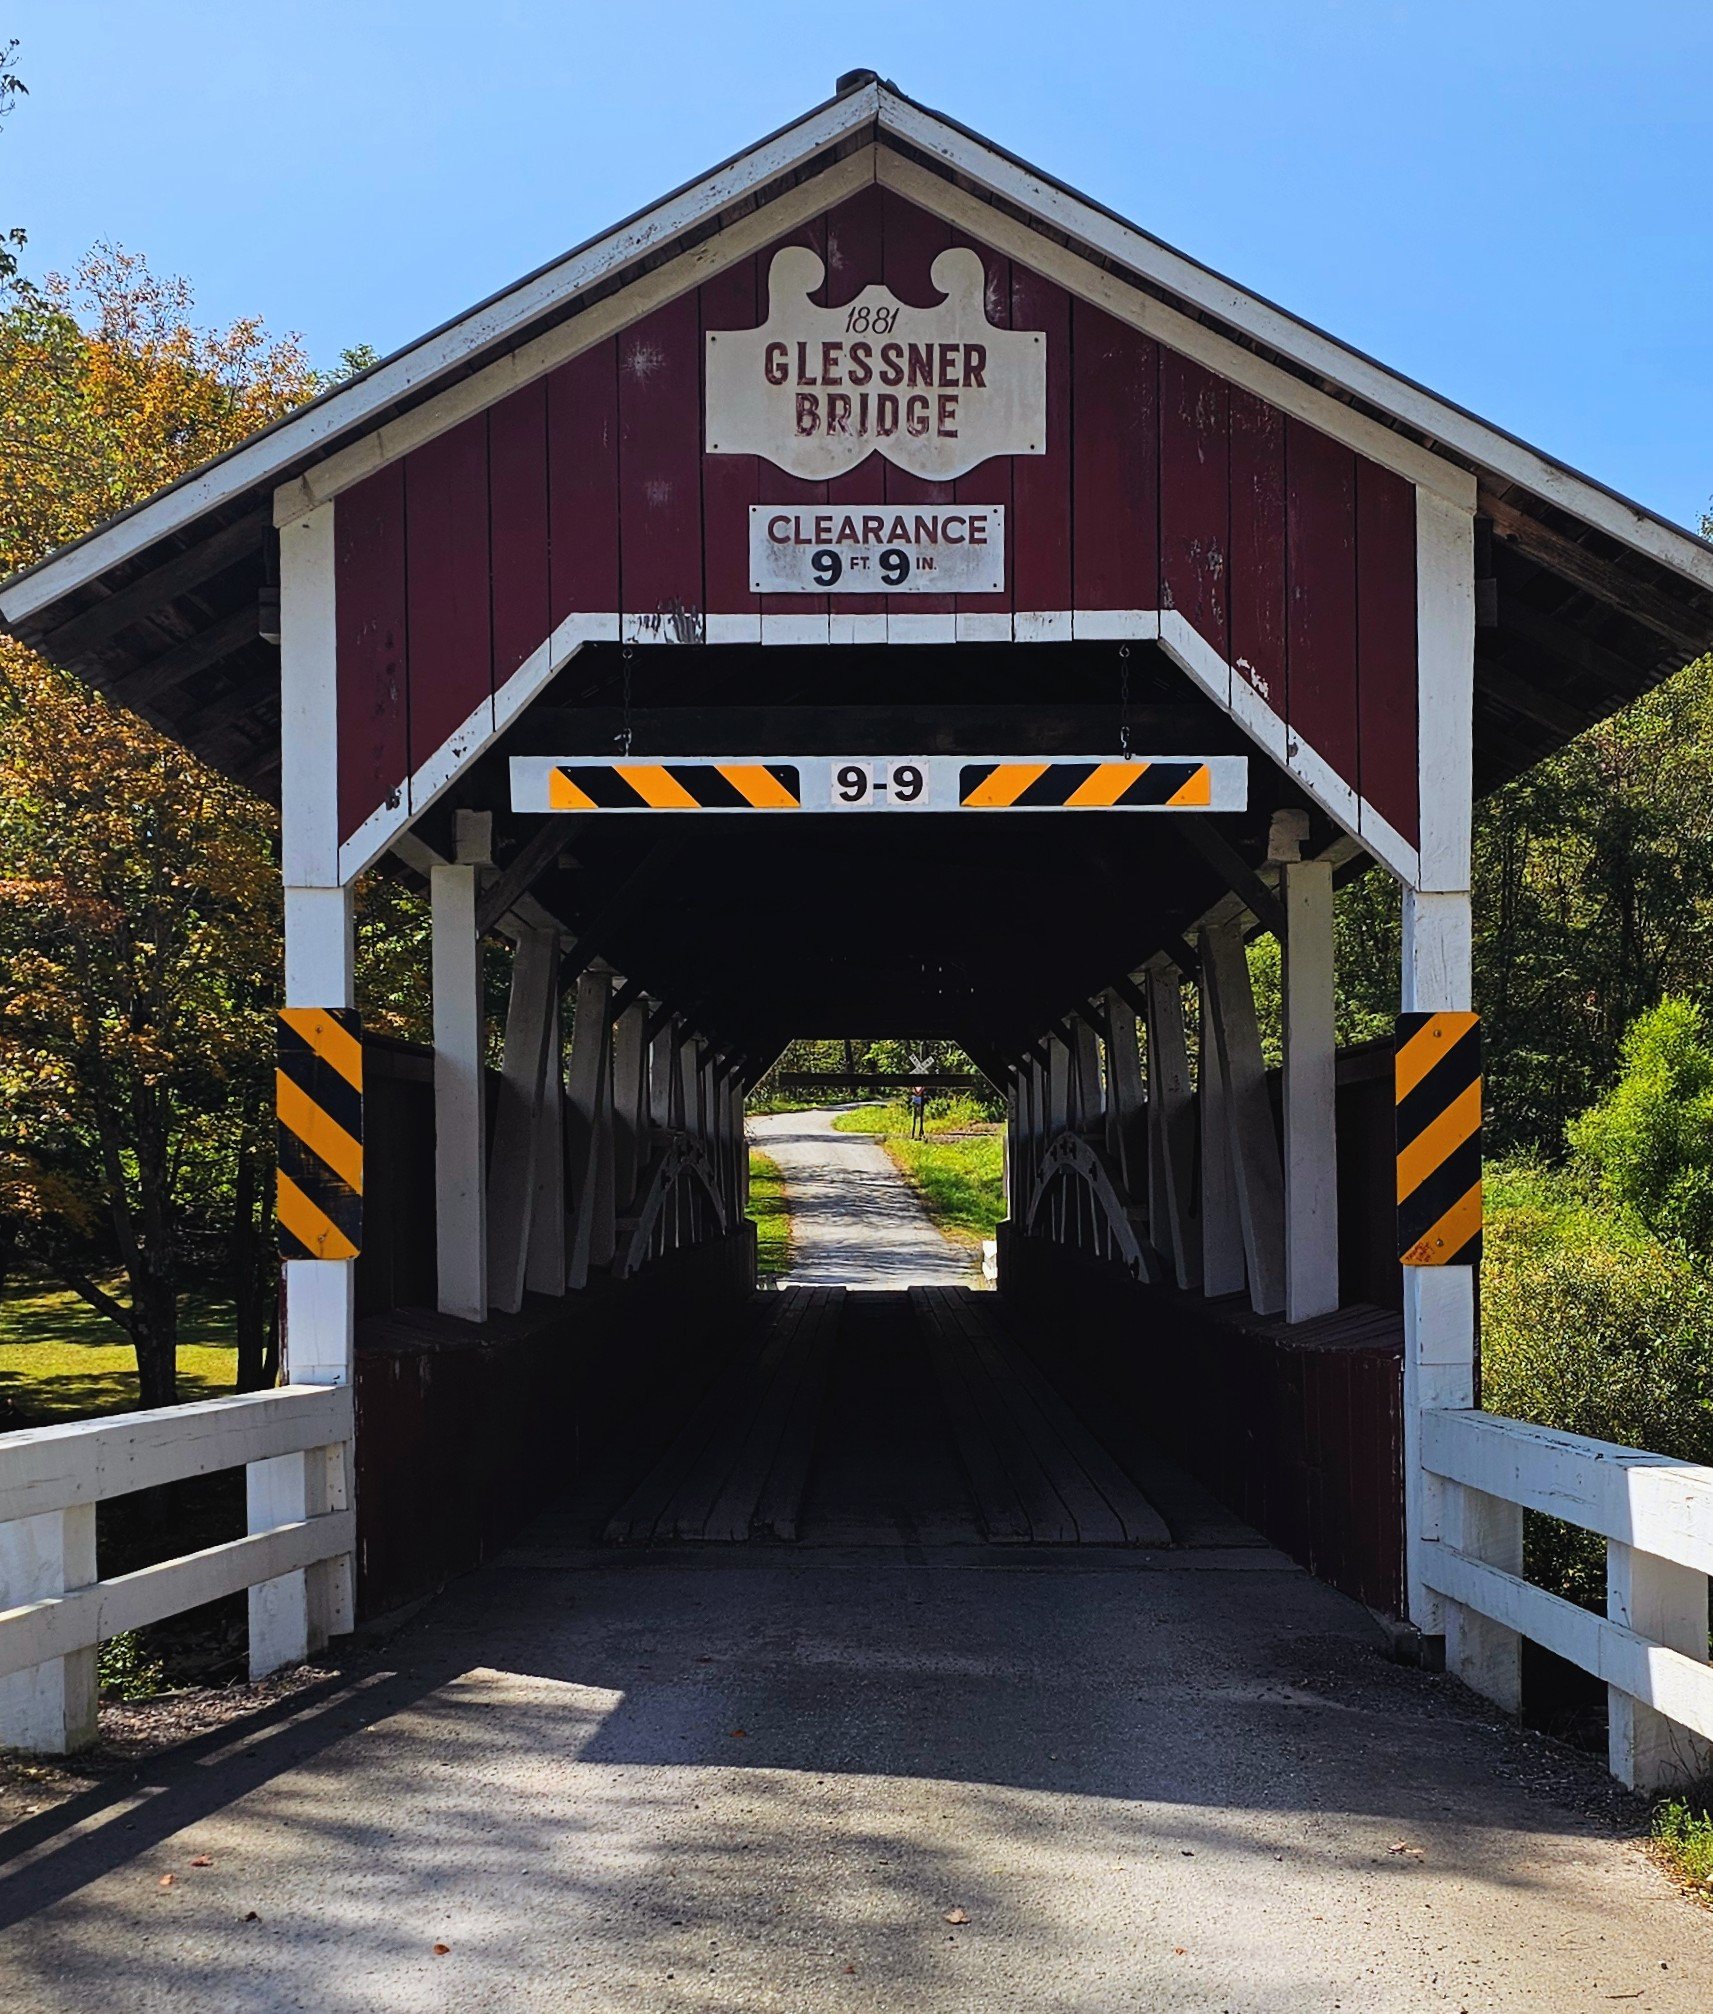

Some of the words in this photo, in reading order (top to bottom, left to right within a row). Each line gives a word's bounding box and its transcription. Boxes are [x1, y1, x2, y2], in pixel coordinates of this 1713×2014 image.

[845, 306, 900, 334] 1881
[764, 341, 988, 388] GLESSNER
[794, 392, 959, 438] BRIDGE
[767, 515, 988, 545] CLEARANCE
[811, 548, 843, 587] 9
[850, 556, 871, 570] FT.
[878, 548, 911, 587] 9
[916, 557, 937, 571] IN.
[837, 765, 923, 802] 9-9
